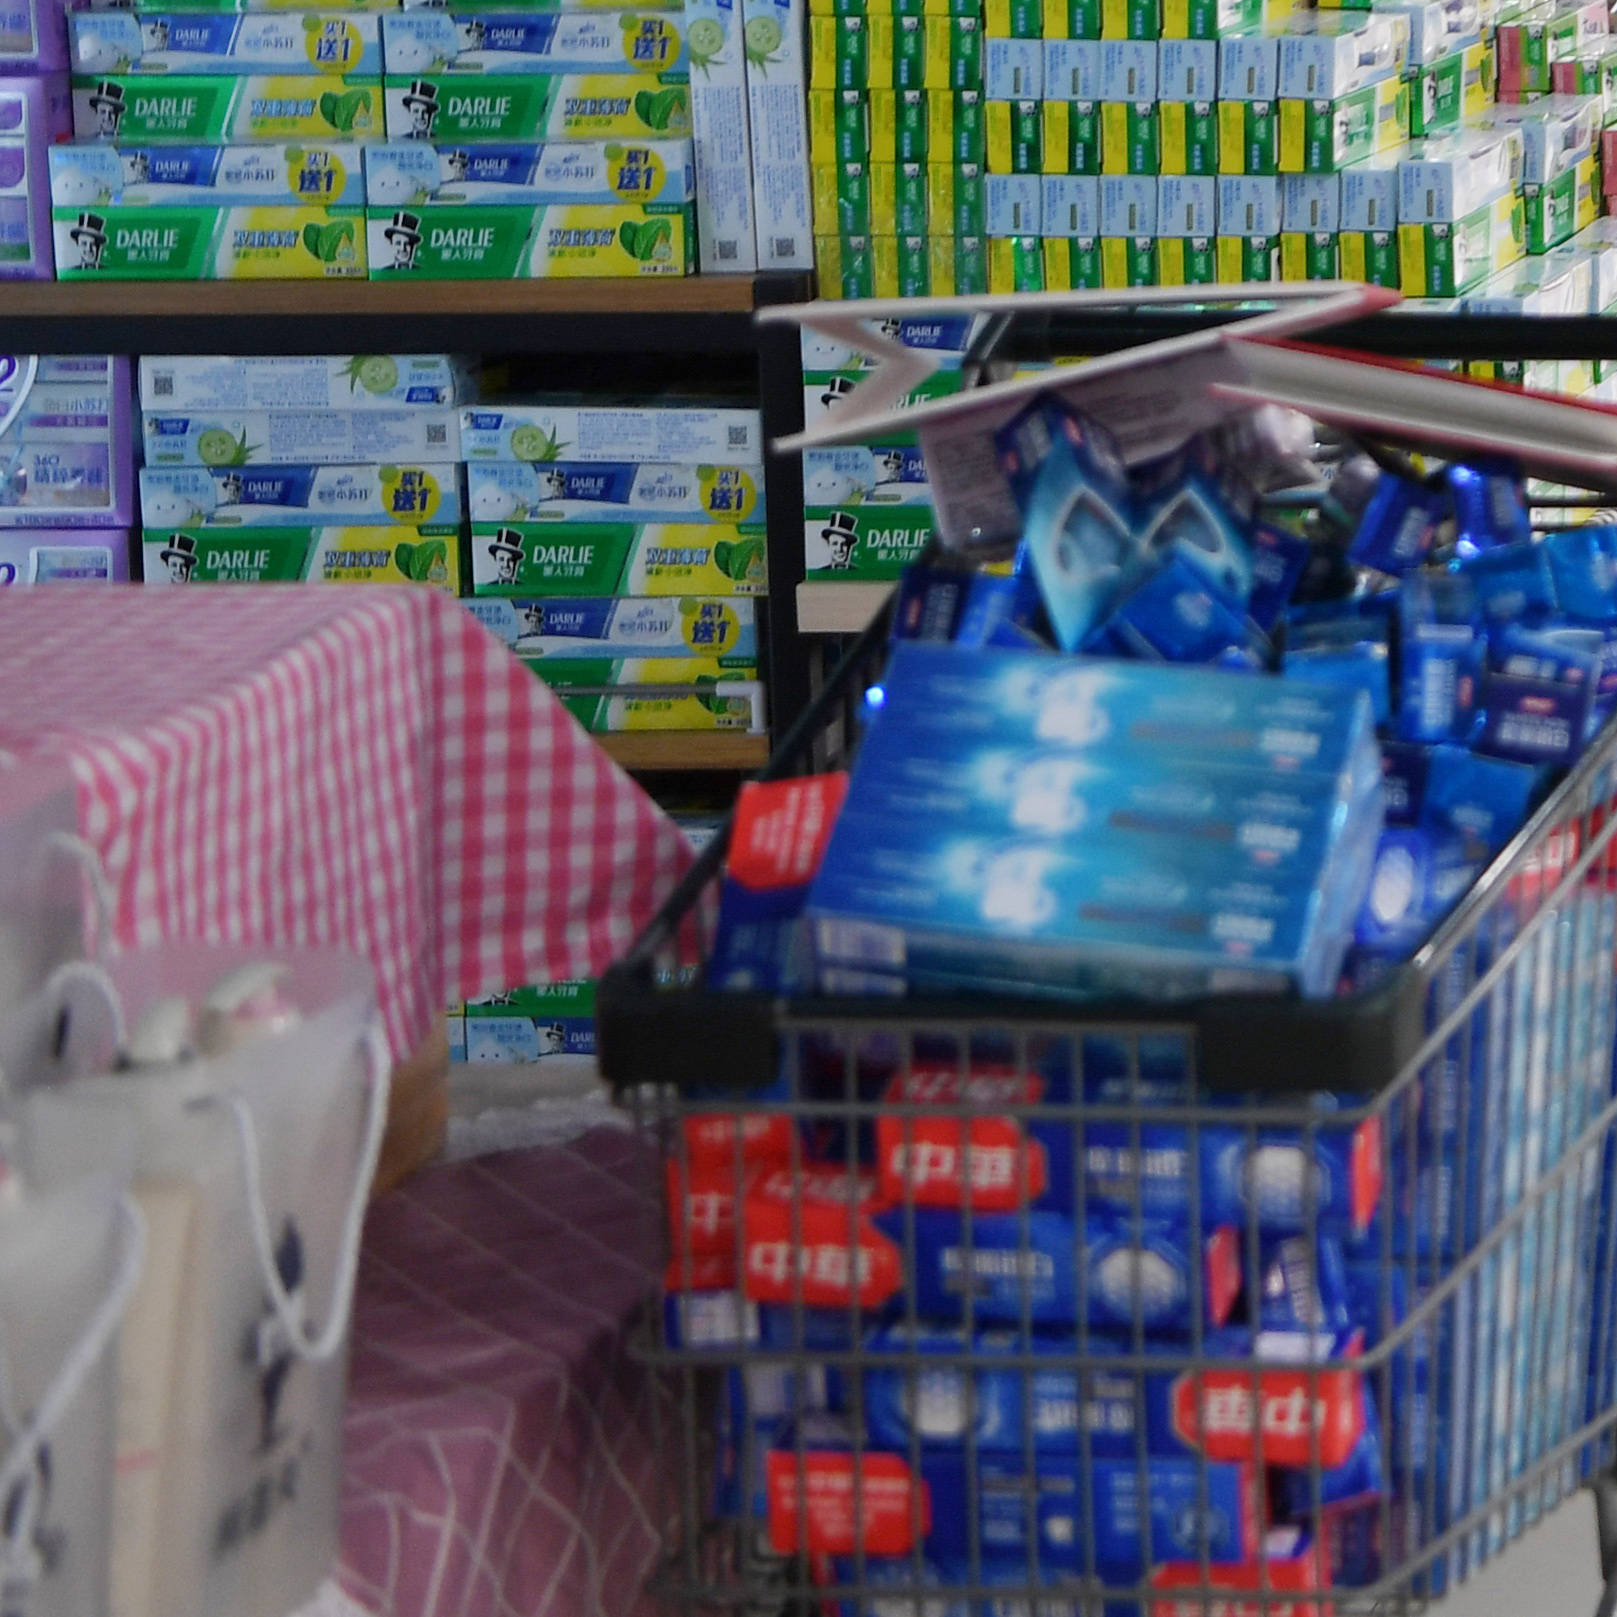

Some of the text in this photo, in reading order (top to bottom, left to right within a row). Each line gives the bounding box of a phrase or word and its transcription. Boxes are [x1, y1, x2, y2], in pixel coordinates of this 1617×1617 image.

[324, 20, 347, 35] 买1
[640, 19, 665, 34] 买1
[316, 37, 351, 61] 送1
[632, 36, 672, 61] 送1
[134, 96, 198, 118] DARLIE
[447, 95, 512, 116] DARLIE
[305, 151, 329, 166] 买1
[625, 149, 650, 164] 买1
[298, 169, 337, 193] 送1
[616, 167, 656, 191] 送1
[115, 228, 180, 248] DARLIE
[430, 227, 495, 248] DARLIE
[906, 324, 943, 338] DARLIE
[400, 471, 424, 487] 买1
[717, 470, 741, 485] 买1
[392, 488, 431, 512] 送1
[708, 487, 747, 511] 送1
[866, 527, 932, 549] DARLIE
[206, 549, 270, 570] DARLIE
[532, 544, 595, 565] DARLIE
[700, 603, 724, 619] 买1
[691, 619, 731, 644] 送1
